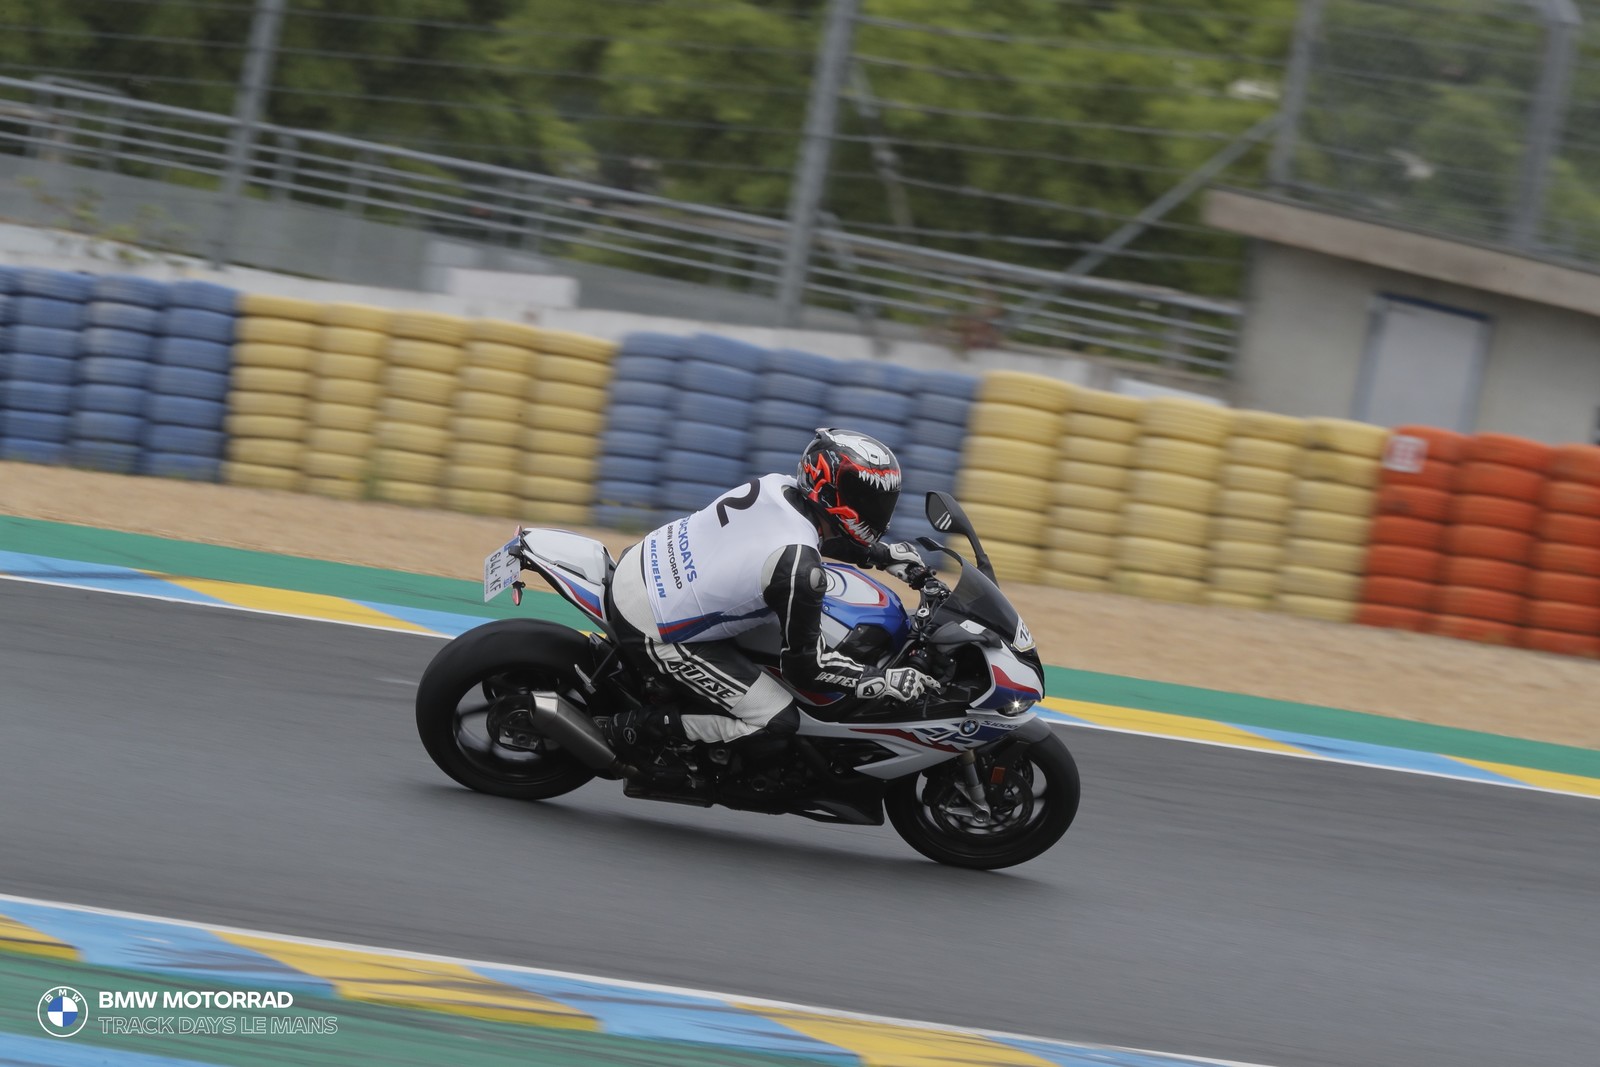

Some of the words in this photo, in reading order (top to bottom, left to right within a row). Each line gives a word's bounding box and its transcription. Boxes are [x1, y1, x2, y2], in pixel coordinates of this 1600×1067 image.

[716, 478, 761, 528] 2
[650, 539, 667, 599] MICHELIN
[668, 543, 683, 590] MOTORRAD
[814, 672, 859, 688] DAINES
